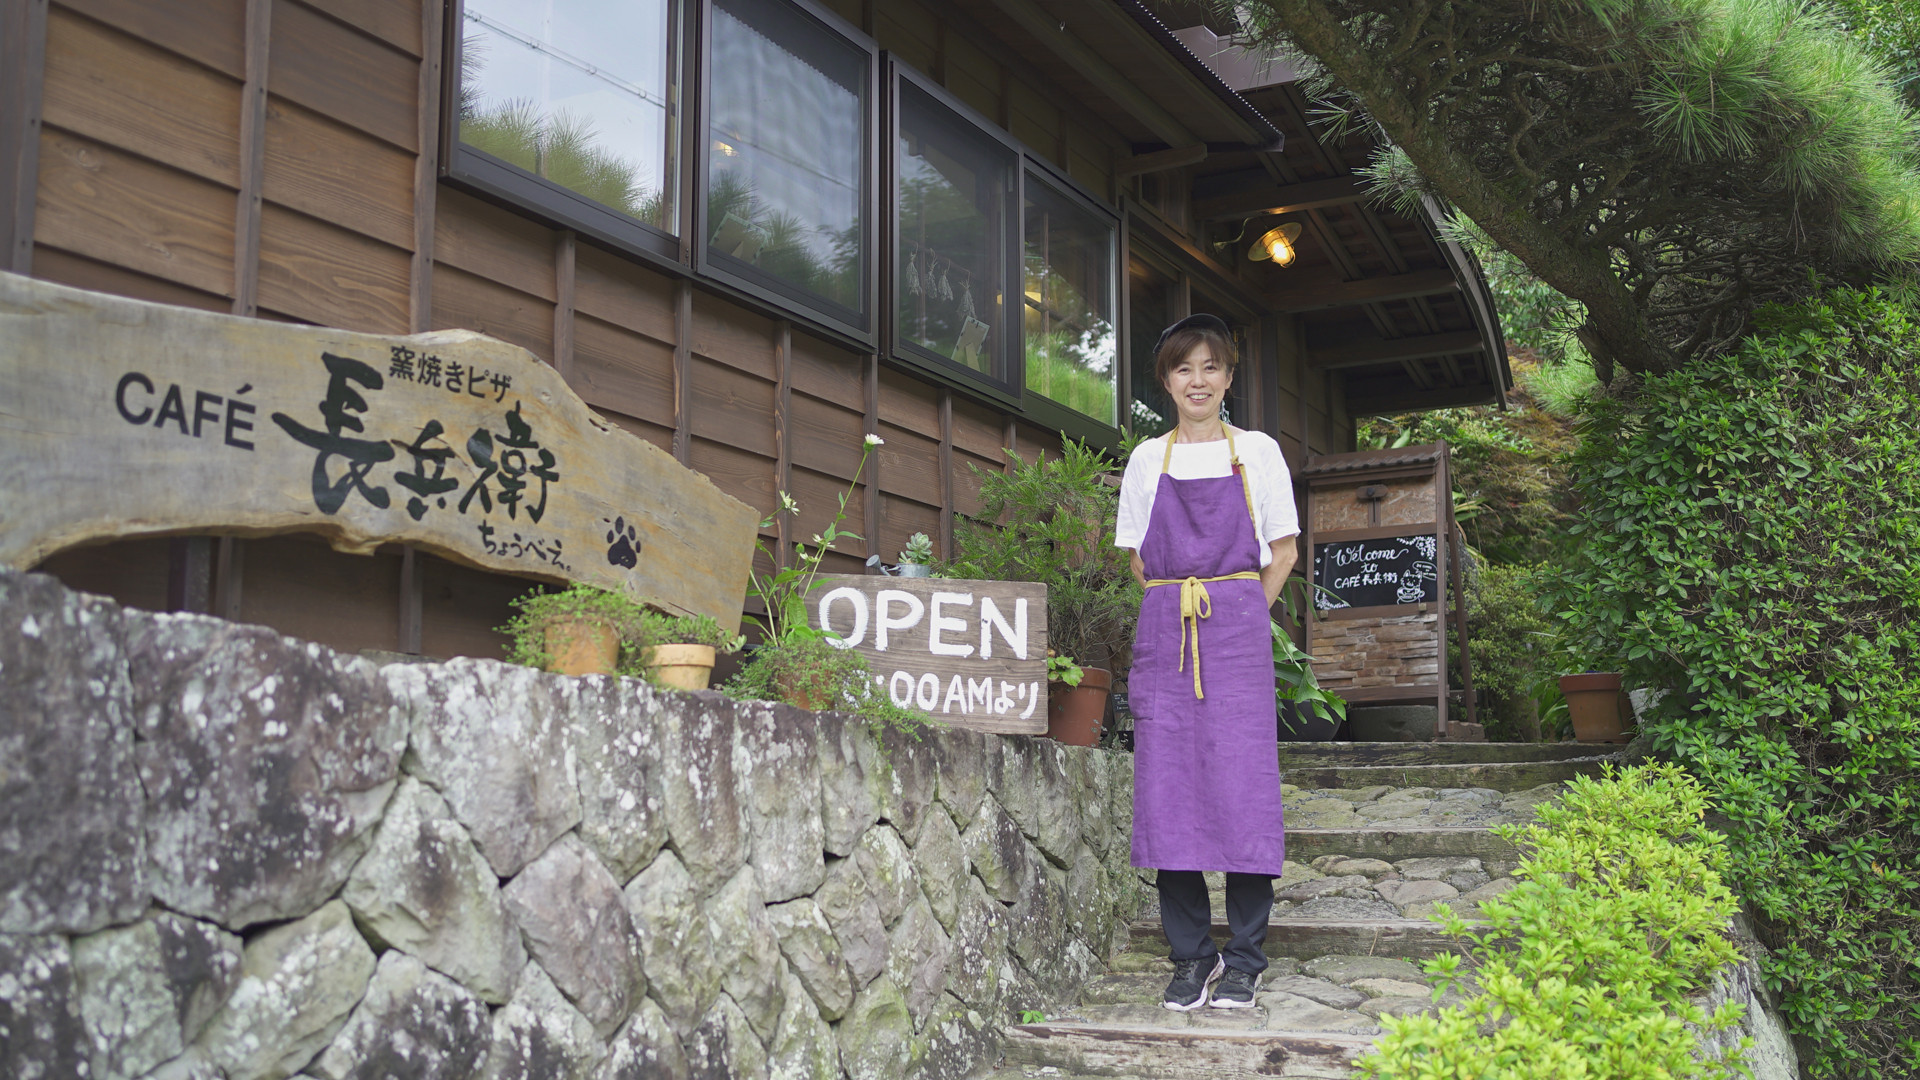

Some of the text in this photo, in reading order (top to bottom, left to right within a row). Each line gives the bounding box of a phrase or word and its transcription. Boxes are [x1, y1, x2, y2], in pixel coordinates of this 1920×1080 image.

[389, 346, 512, 403] 窯焼きピザ
[115, 372, 256, 451] CAFÉ
[1331, 544, 1409, 566] Welcome
[1361, 562, 1378, 573] to
[1335, 574, 1361, 589] CAFÉ
[819, 587, 1028, 660] OPEN
